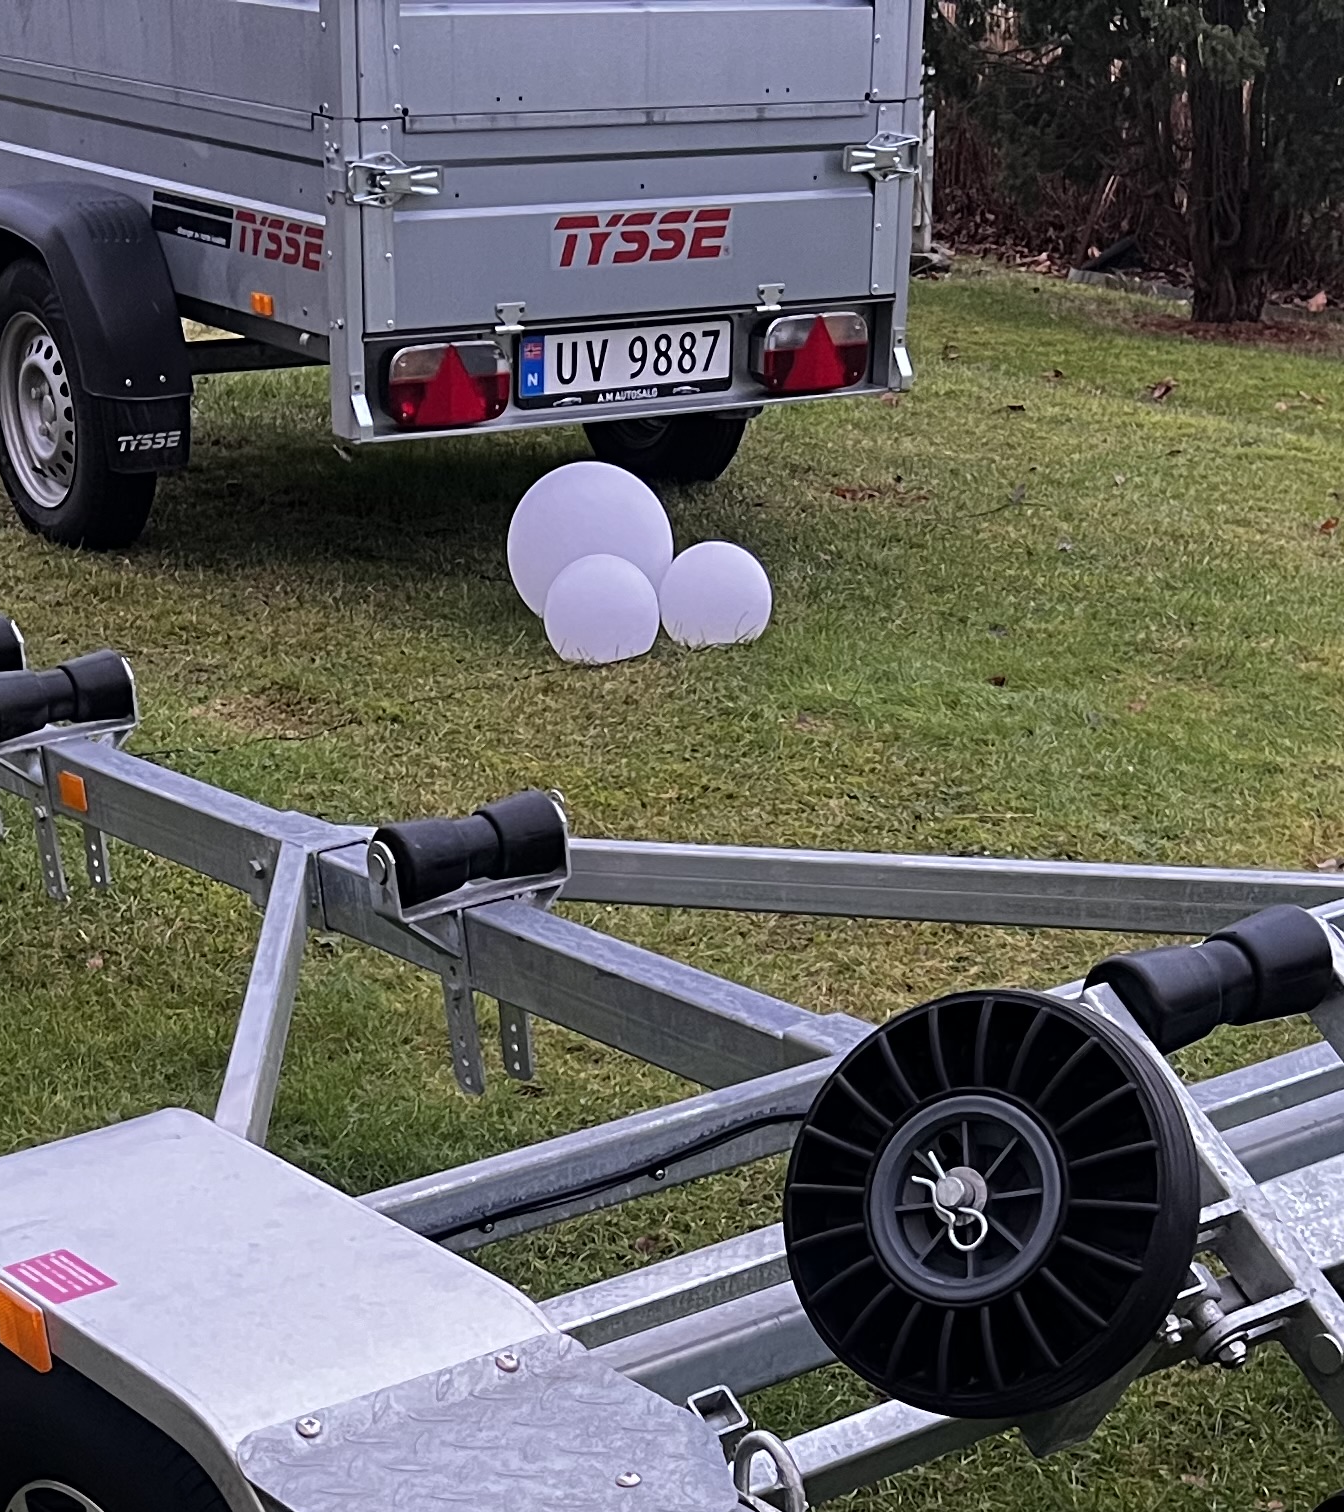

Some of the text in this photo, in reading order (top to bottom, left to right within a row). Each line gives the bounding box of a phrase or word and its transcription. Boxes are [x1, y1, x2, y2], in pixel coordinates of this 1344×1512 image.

[235, 210, 324, 271] TYSSE
[554, 208, 731, 267] TYSSE
[527, 373, 539, 387] N
[556, 329, 721, 385] UV 9887
[117, 430, 182, 452] TYSSE
